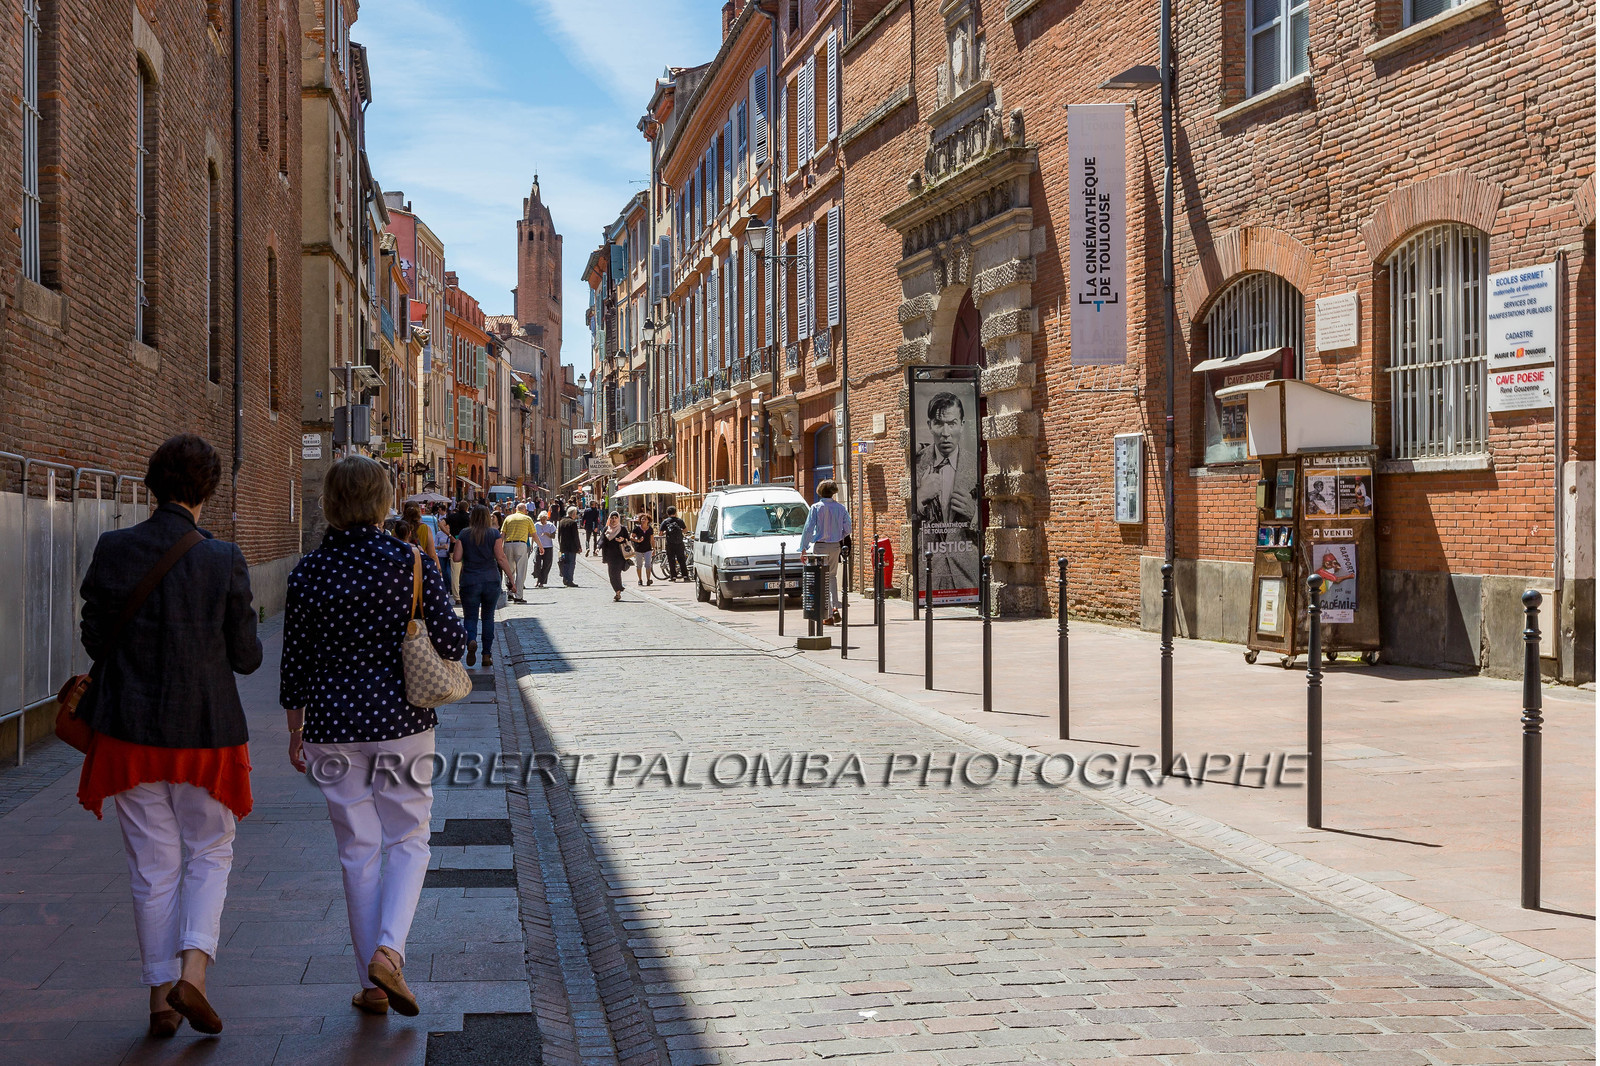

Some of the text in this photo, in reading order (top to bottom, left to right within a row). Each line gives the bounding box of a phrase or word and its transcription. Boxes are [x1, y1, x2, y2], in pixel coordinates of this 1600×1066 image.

[1082, 157, 1098, 296] LA CINÉMATHÈQUE
[1099, 193, 1110, 296] DE TOULOUSE
[1496, 270, 1544, 286] ECOLES SERMET
[1504, 299, 1526, 309] SERVICES
[1489, 305, 1552, 319] MANIFESTATIONS PUBLIQUES
[1505, 330, 1533, 340] CADASTRE
[1494, 351, 1509, 359] MAIRIE
[1525, 347, 1546, 355] TOULOUSE
[1227, 372, 1270, 385] CAVE POESIE
[1496, 371, 1544, 385] CAVE POESIE
[1500, 385, 1539, 394] René Gouzenne
[1324, 529, 1353, 537] VENIR
[928, 541, 972, 552] JUSTICE
[1340, 546, 1355, 574] RAPPORT
[1320, 595, 1357, 610] CADÉMIE
